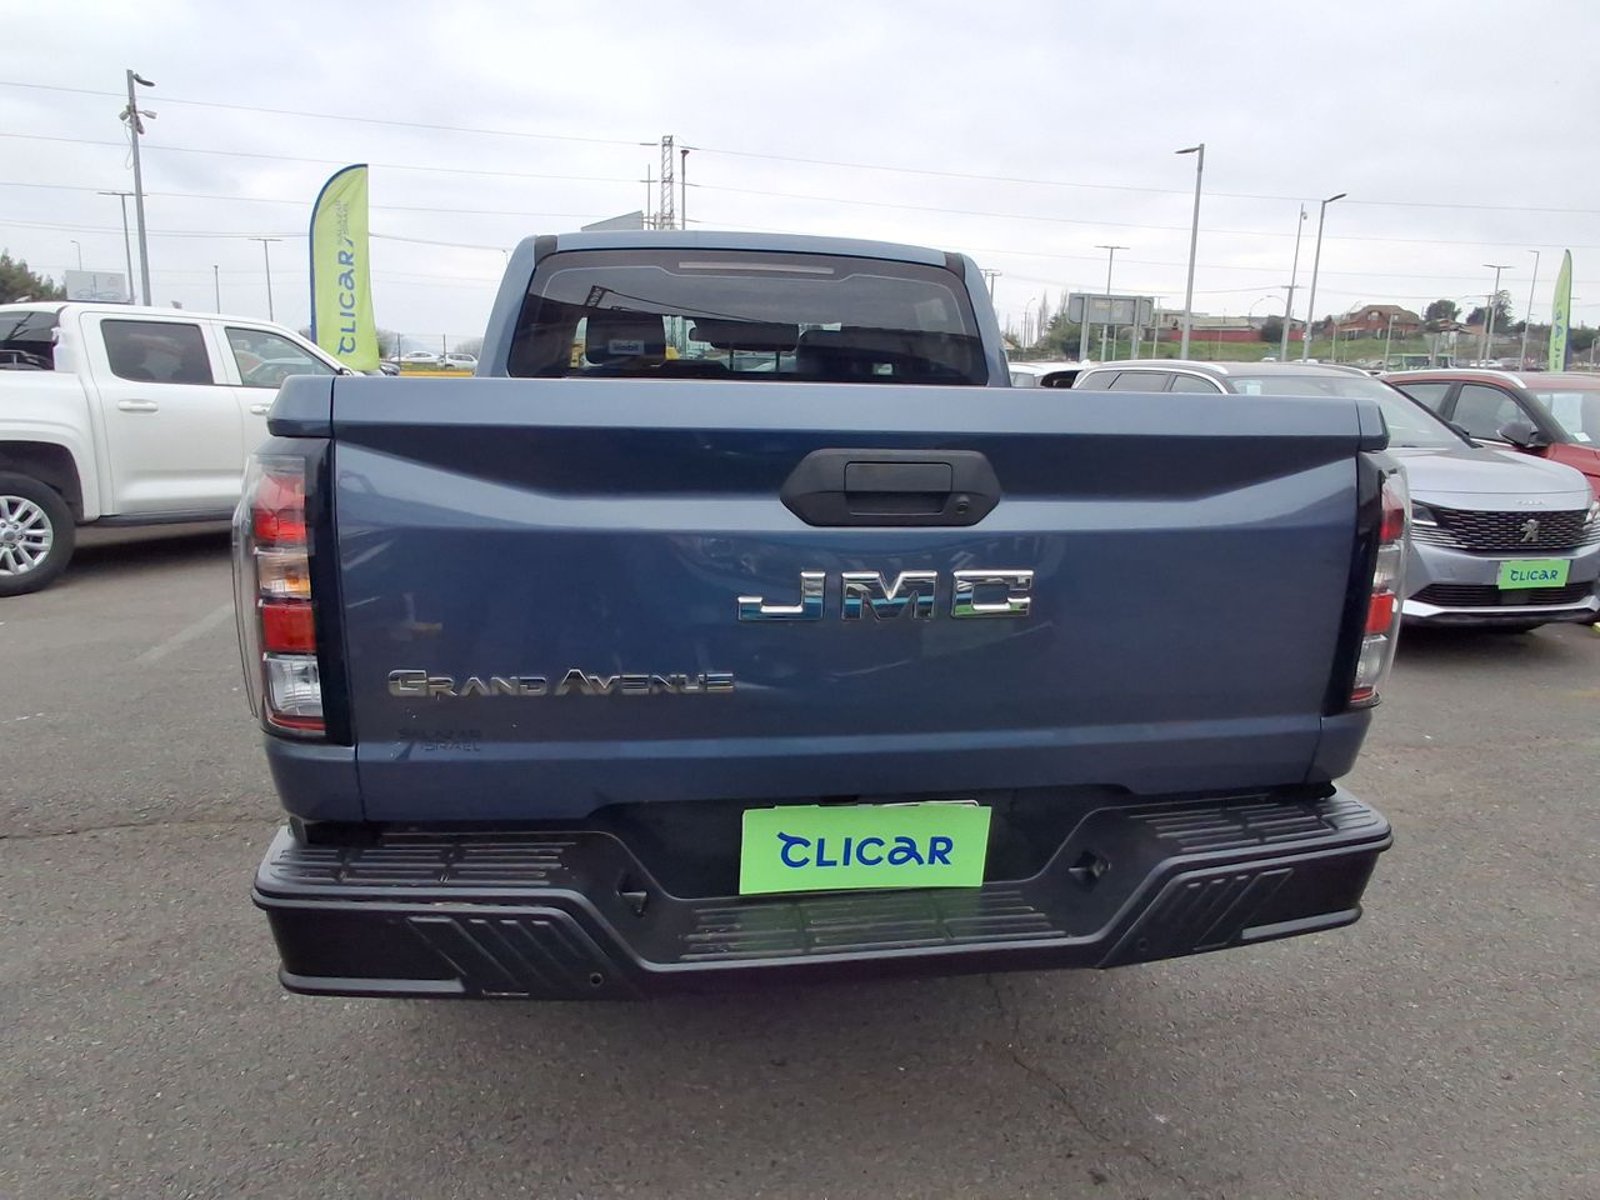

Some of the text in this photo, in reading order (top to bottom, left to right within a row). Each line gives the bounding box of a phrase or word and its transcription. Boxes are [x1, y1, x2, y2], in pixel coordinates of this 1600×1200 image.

[738, 570, 1034, 622] JMC
[388, 668, 735, 698] GRAND AVENUE
